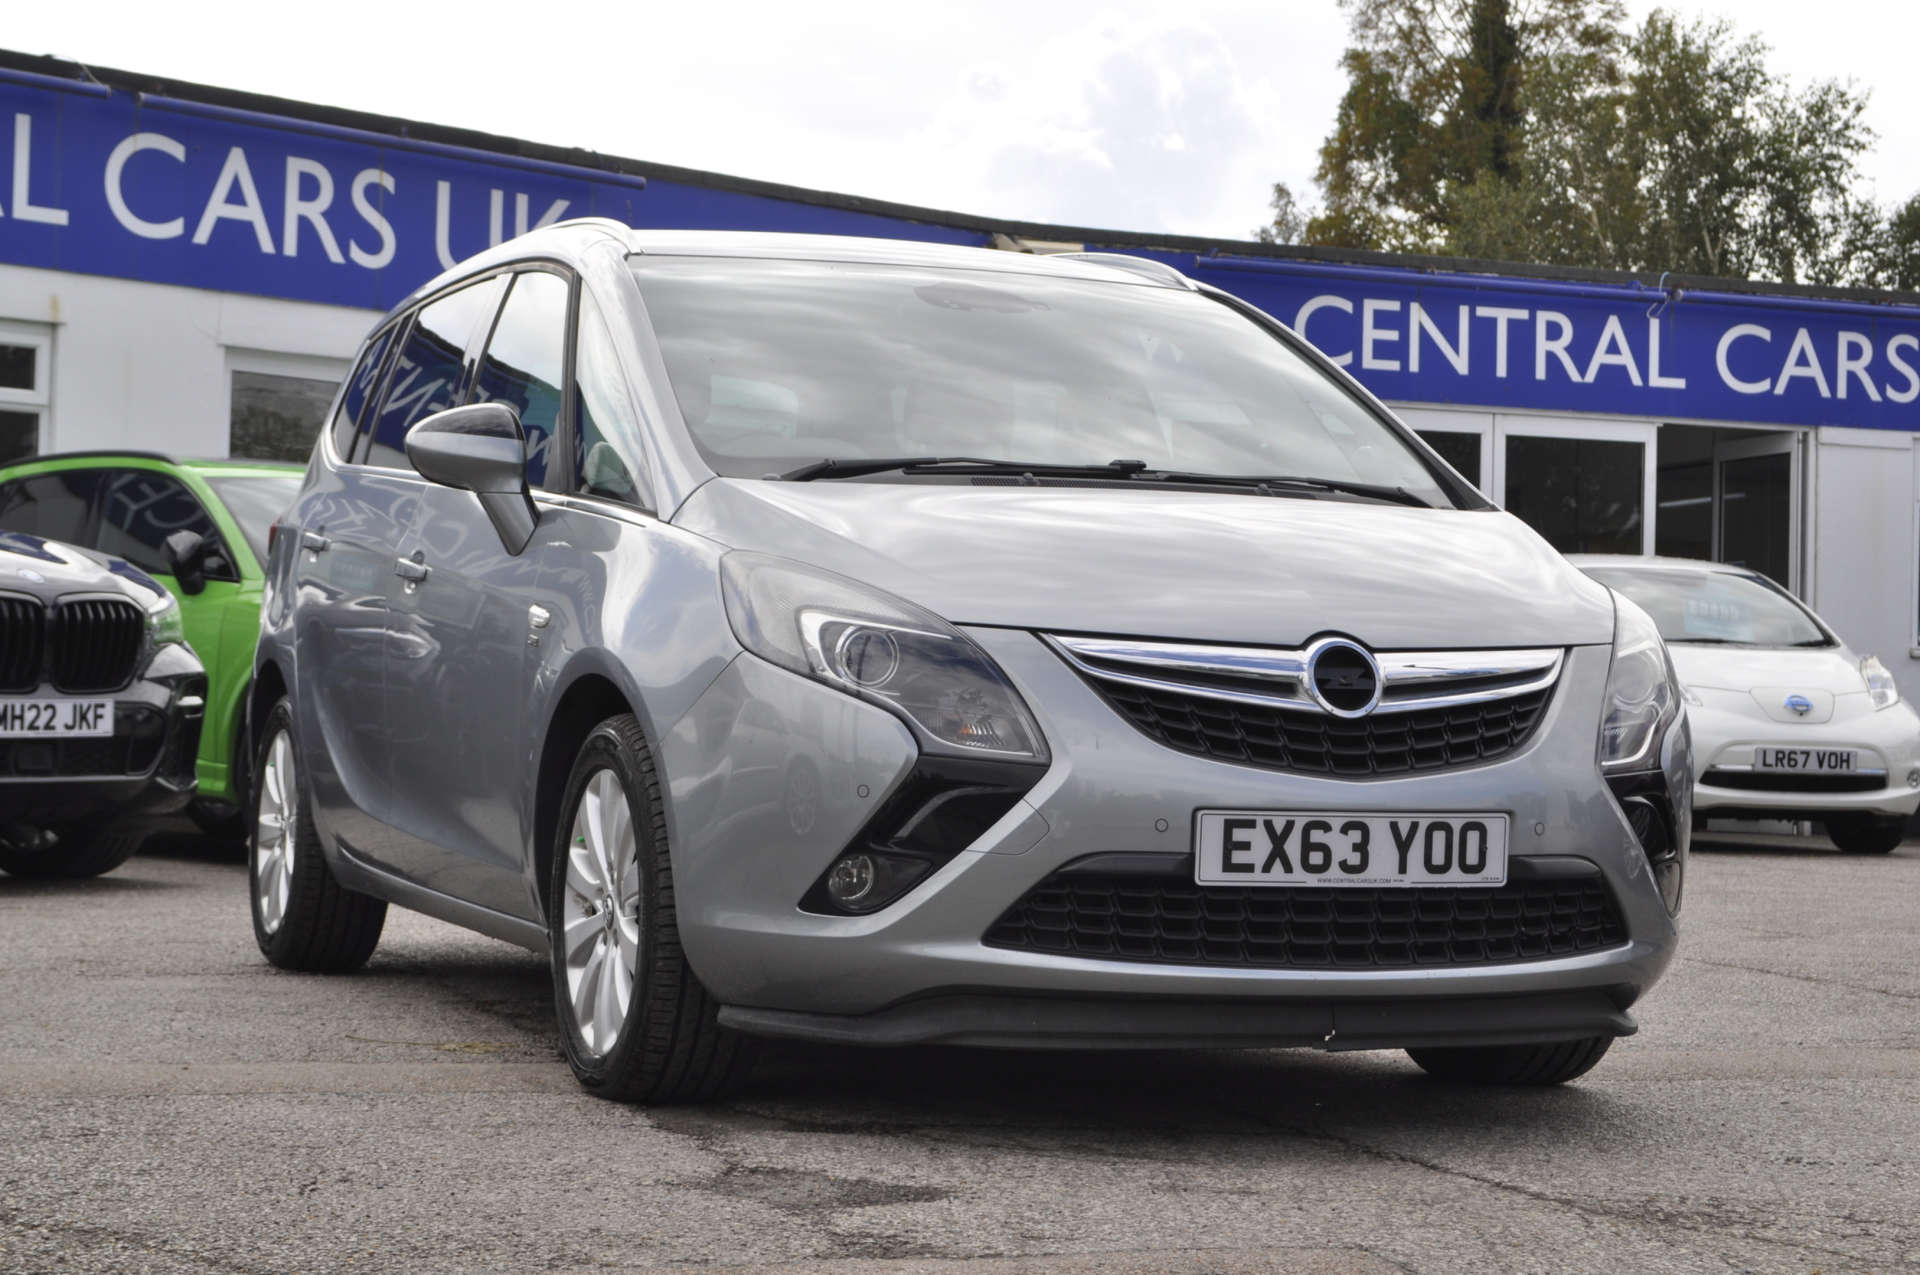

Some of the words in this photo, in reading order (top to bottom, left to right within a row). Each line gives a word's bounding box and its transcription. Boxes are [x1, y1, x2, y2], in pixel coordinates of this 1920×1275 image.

[0, 113, 69, 226] L
[104, 132, 397, 269] CARS
[1294, 295, 1686, 389] CENTRAL
[1716, 323, 1920, 403] CARS
[64, 703, 105, 730] JKF
[1762, 750, 1810, 769] LR67
[1816, 751, 1850, 769] VOH
[1222, 819, 1370, 874] EX63
